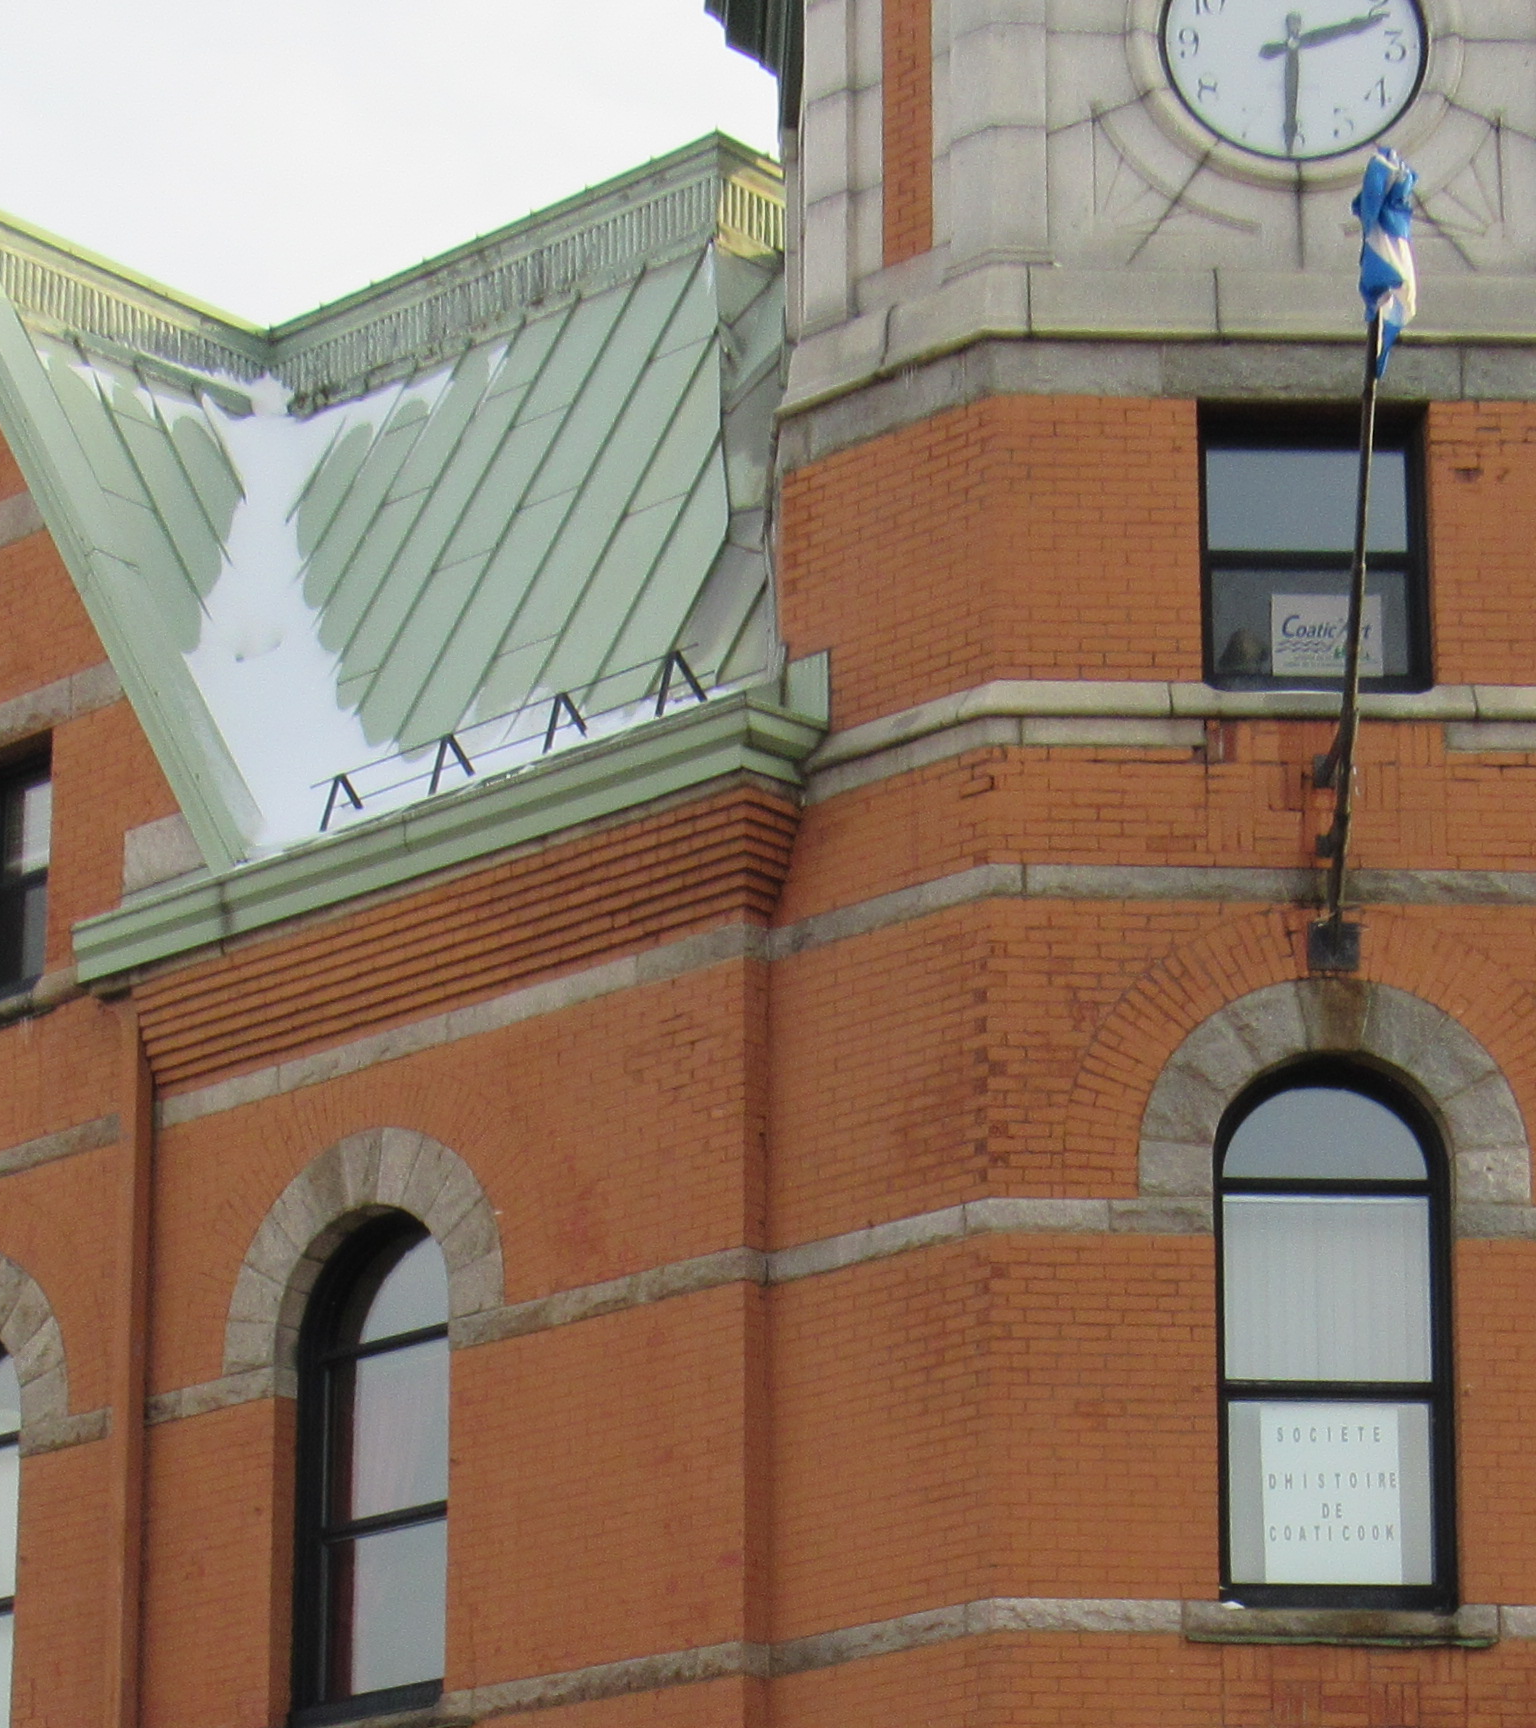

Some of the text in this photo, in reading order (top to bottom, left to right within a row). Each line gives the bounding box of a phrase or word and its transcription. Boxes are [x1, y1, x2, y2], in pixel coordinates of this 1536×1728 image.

[1178, 27, 1200, 59] 9
[1384, 28, 1407, 62] 3
[1276, 1426, 1381, 1443] SOCIETE
[1268, 1472, 1397, 1490] DHISTOIRE
[1321, 1503, 1343, 1519] DE
[1268, 1524, 1395, 1542] COATICOOK
